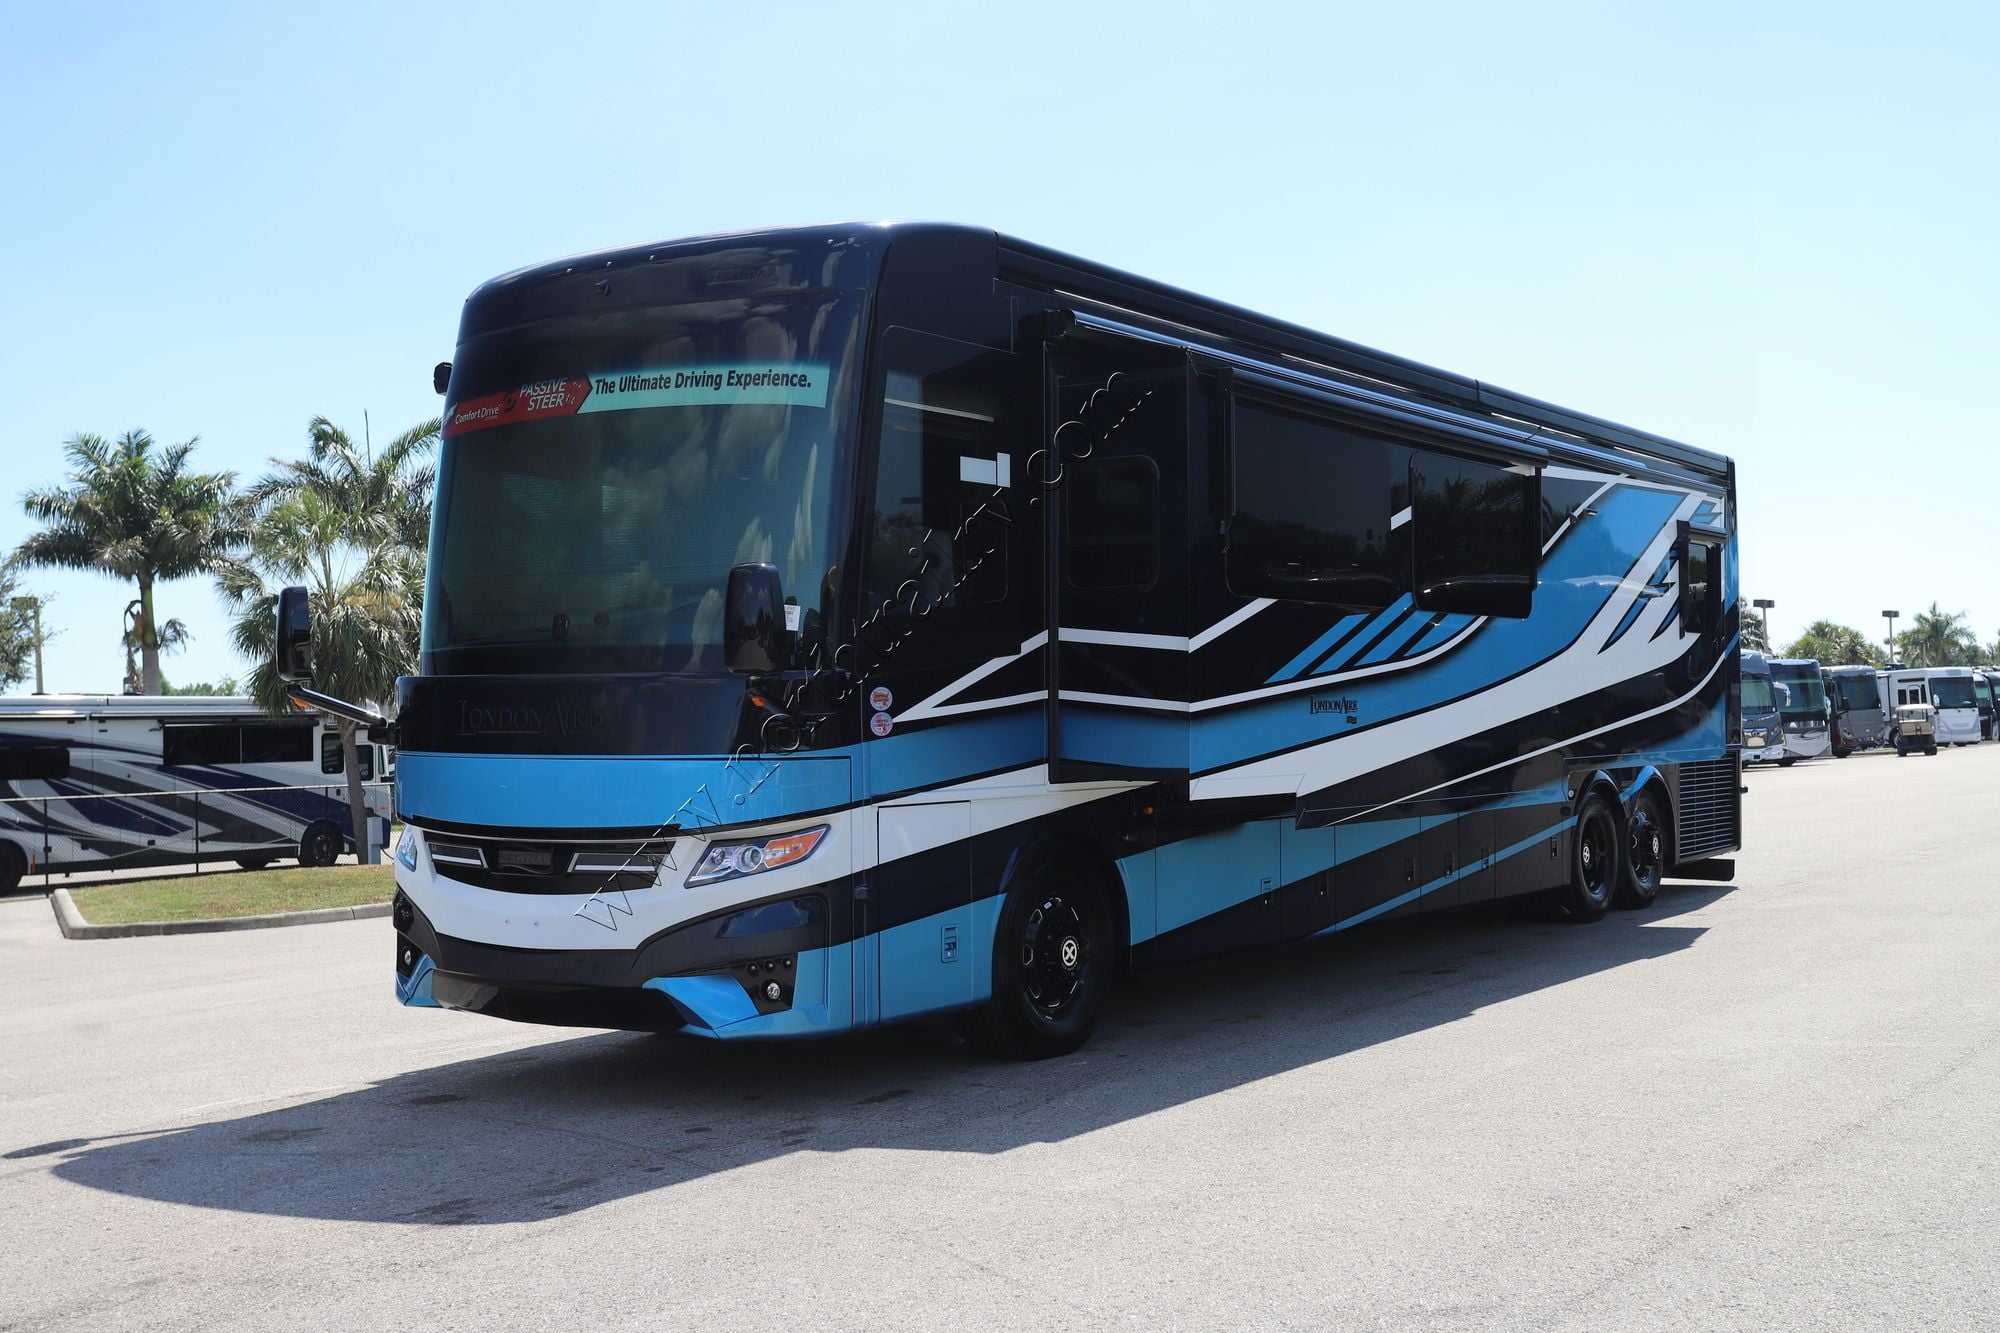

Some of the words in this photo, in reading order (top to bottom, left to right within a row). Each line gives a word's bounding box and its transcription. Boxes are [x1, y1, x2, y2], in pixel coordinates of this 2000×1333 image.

[519, 379, 567, 398] PASSIVE
[595, 379, 615, 395] The
[619, 374, 671, 392] Ultimate
[674, 372, 722, 391] Driving
[727, 369, 812, 390] Experience.
[527, 392, 564, 411] STEER
[455, 408, 481, 424] Comfort
